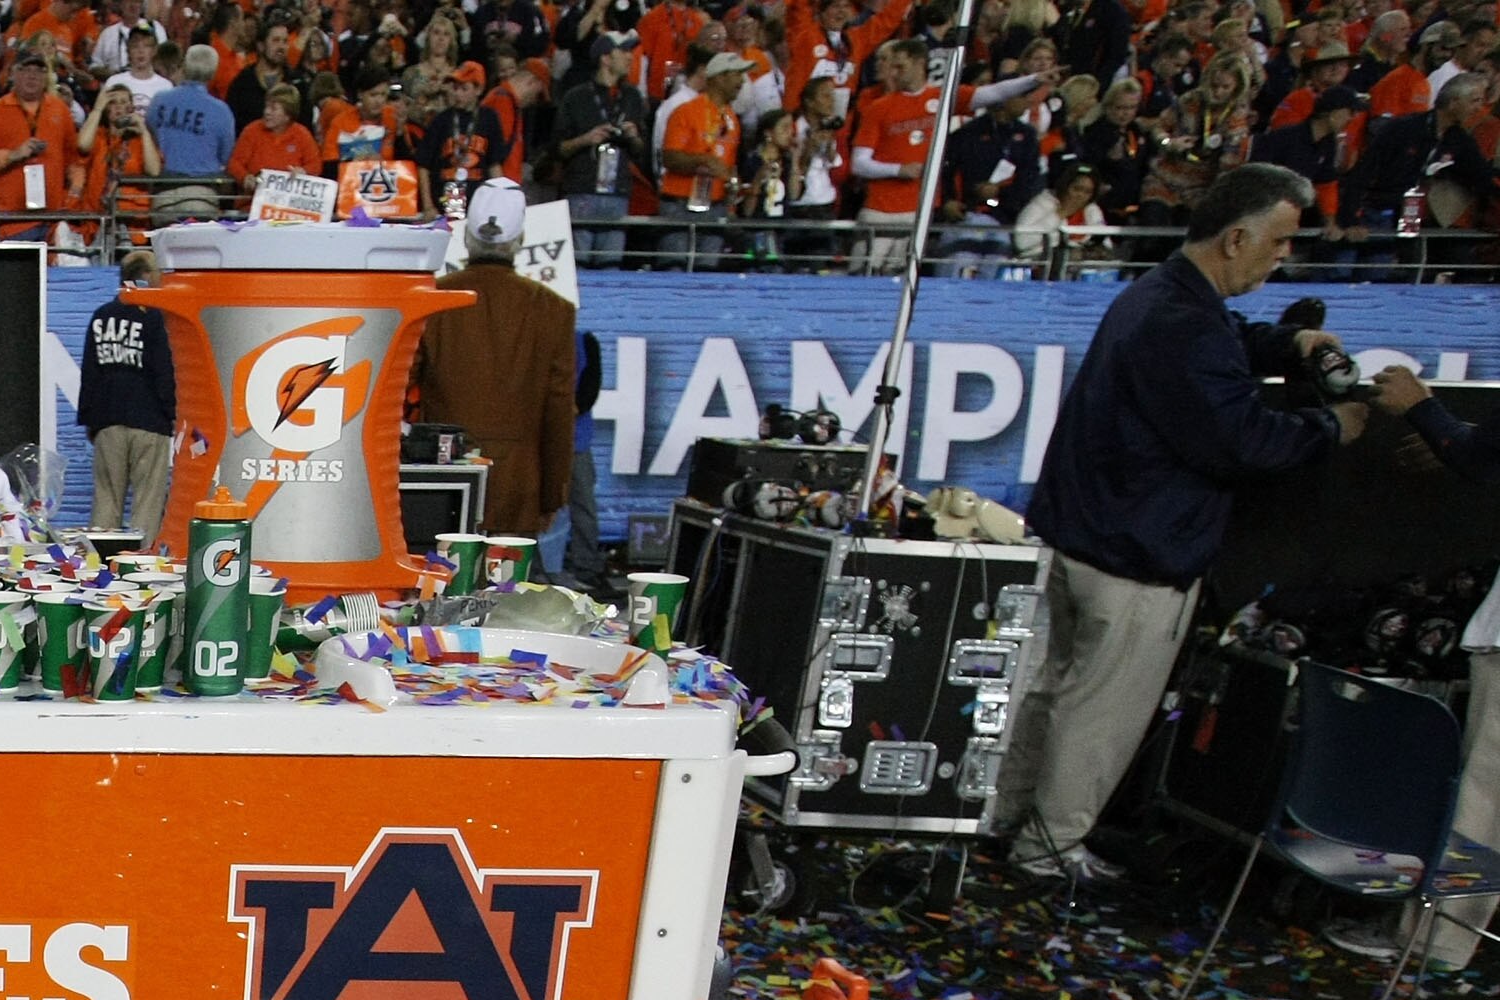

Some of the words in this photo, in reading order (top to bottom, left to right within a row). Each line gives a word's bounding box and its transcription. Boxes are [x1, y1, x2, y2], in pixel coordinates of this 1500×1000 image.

[266, 174, 329, 199] PROTECT
[245, 334, 347, 454] G
[591, 337, 1066, 484] HAMPI
[241, 457, 344, 484] SERIES
[202, 538, 242, 587] G
[194, 640, 239, 678] 02
